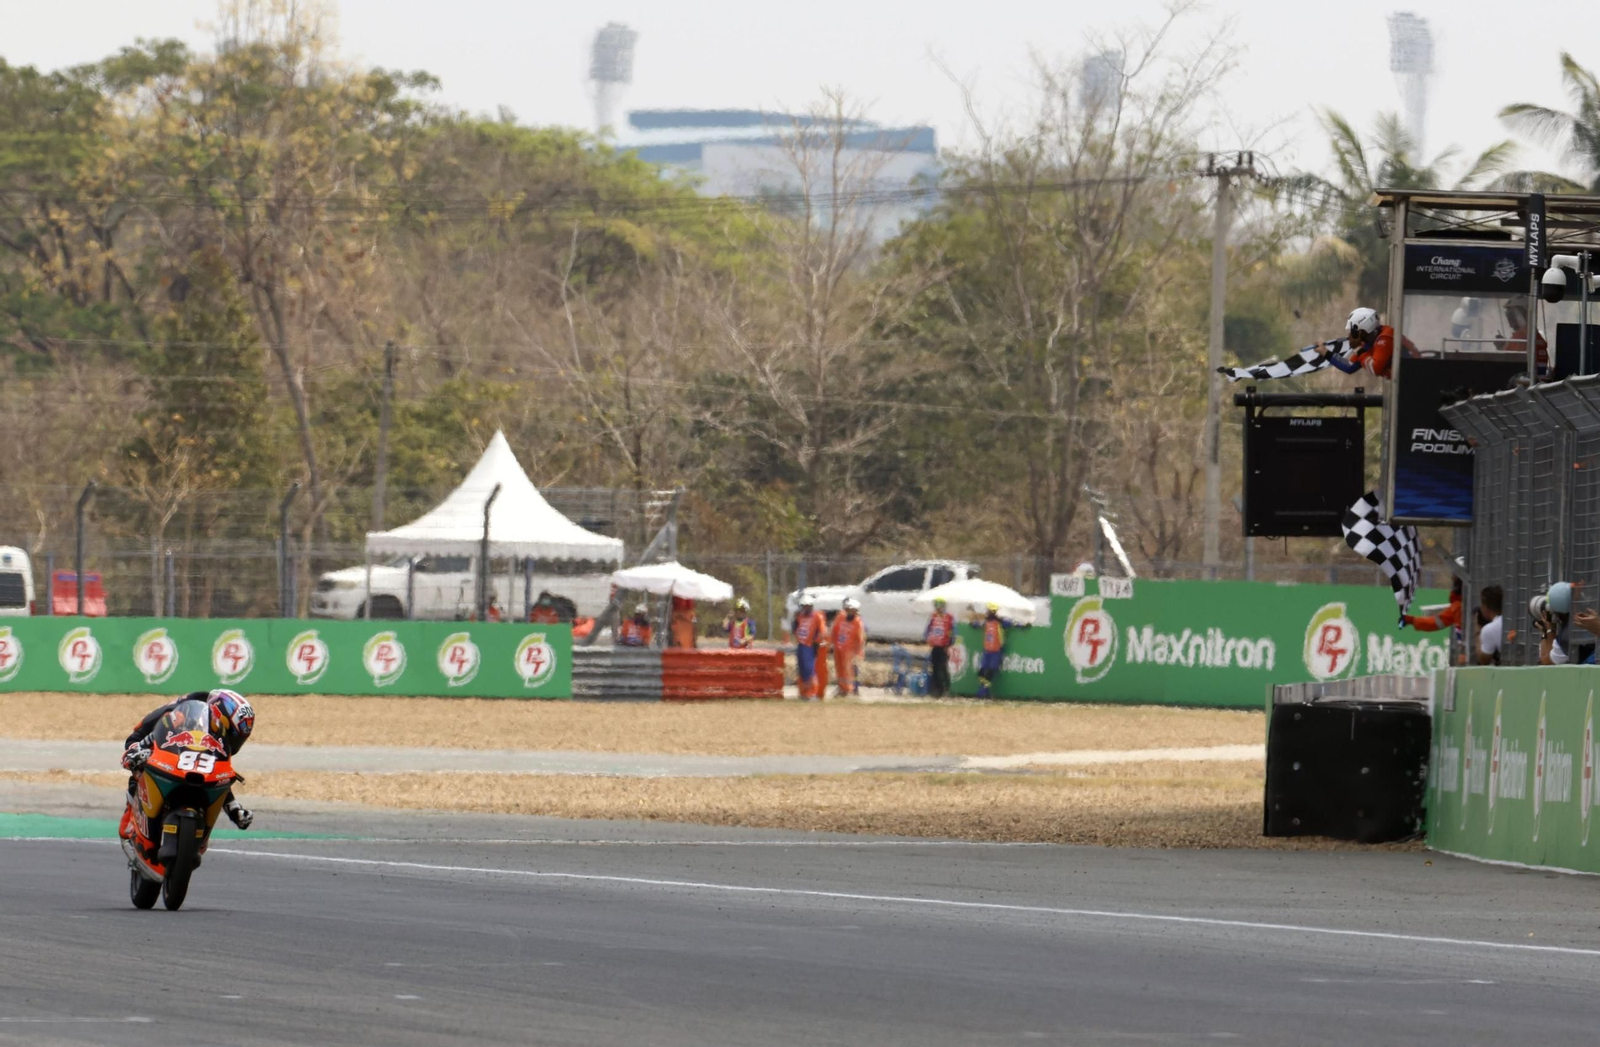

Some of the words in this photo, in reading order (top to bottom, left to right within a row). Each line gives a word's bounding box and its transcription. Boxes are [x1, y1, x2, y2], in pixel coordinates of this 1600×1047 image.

[1529, 213, 1540, 267] MYLAPS
[1430, 256, 1462, 267] Chang
[1415, 266, 1477, 275] INTERNATIONAL
[1411, 428, 1465, 441] FINIS
[1410, 443, 1476, 455] PODIUM
[1125, 624, 1276, 671] Maxnitron
[177, 750, 218, 774] 83
